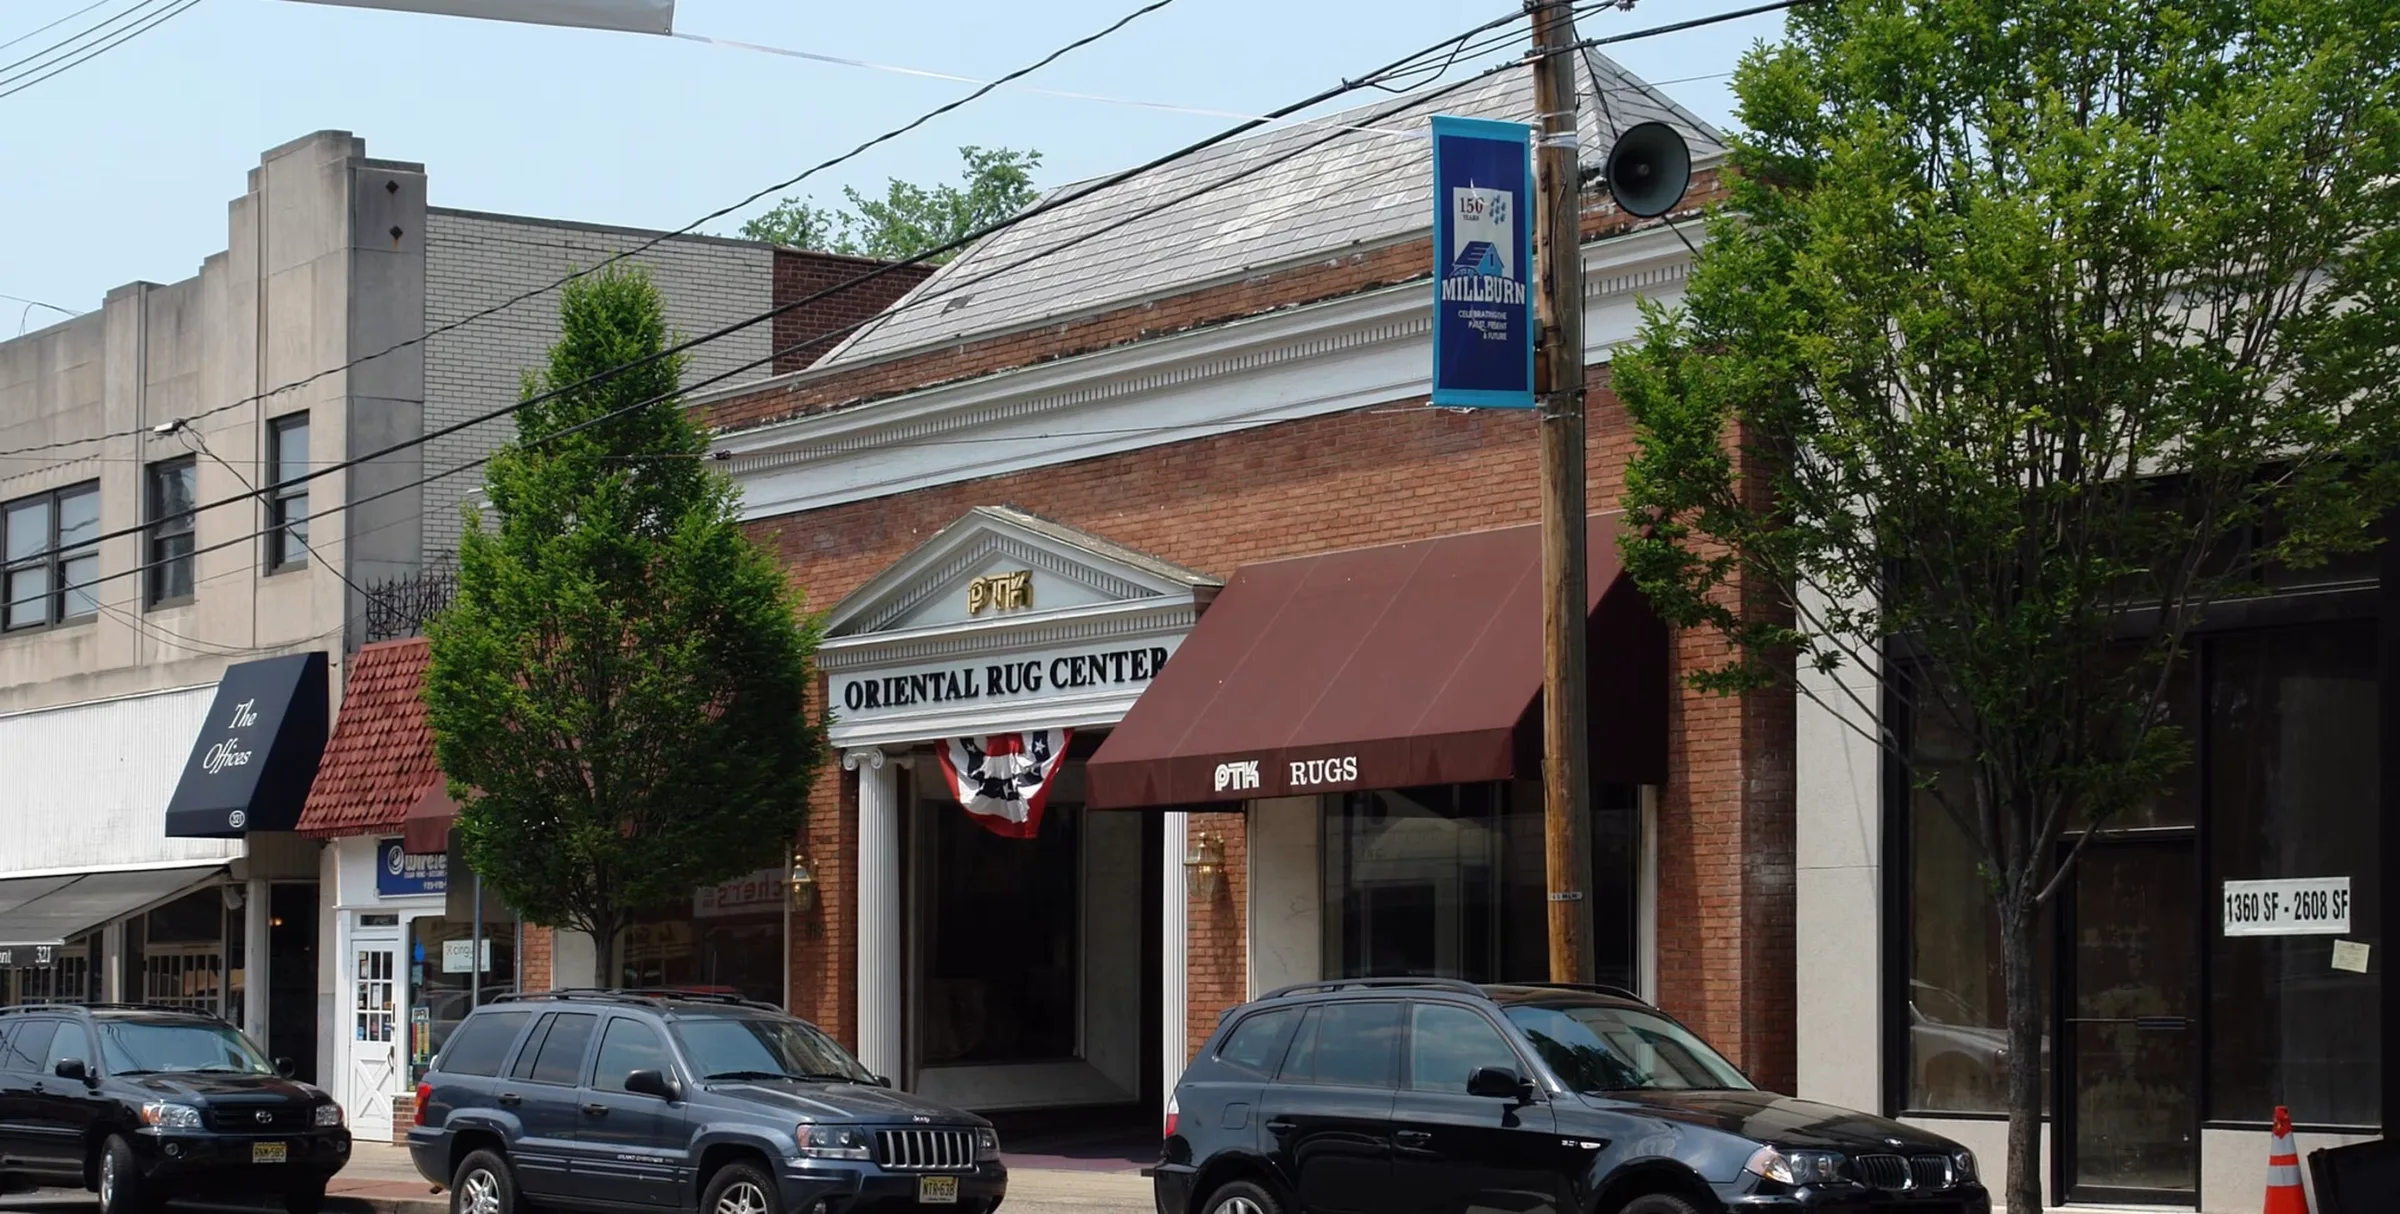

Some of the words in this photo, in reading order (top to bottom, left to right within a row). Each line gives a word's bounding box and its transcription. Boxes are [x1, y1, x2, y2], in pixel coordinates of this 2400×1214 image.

[1442, 275, 1526, 305] MILLBURN
[967, 570, 1033, 615] PTK
[844, 668, 979, 711] ORIENTAL
[986, 661, 1042, 696] RUG
[1049, 647, 1169, 688] CENTER
[228, 698, 258, 729] The
[203, 737, 252, 774] Offices
[1214, 760, 1260, 792] PTK
[1290, 756, 1358, 786] RUGS
[2226, 893, 2259, 922] 1360
[2264, 891, 2279, 922] SF
[2294, 890, 2327, 920] 2608
[2332, 889, 2348, 919] SF
[35, 945, 51, 963] 321
